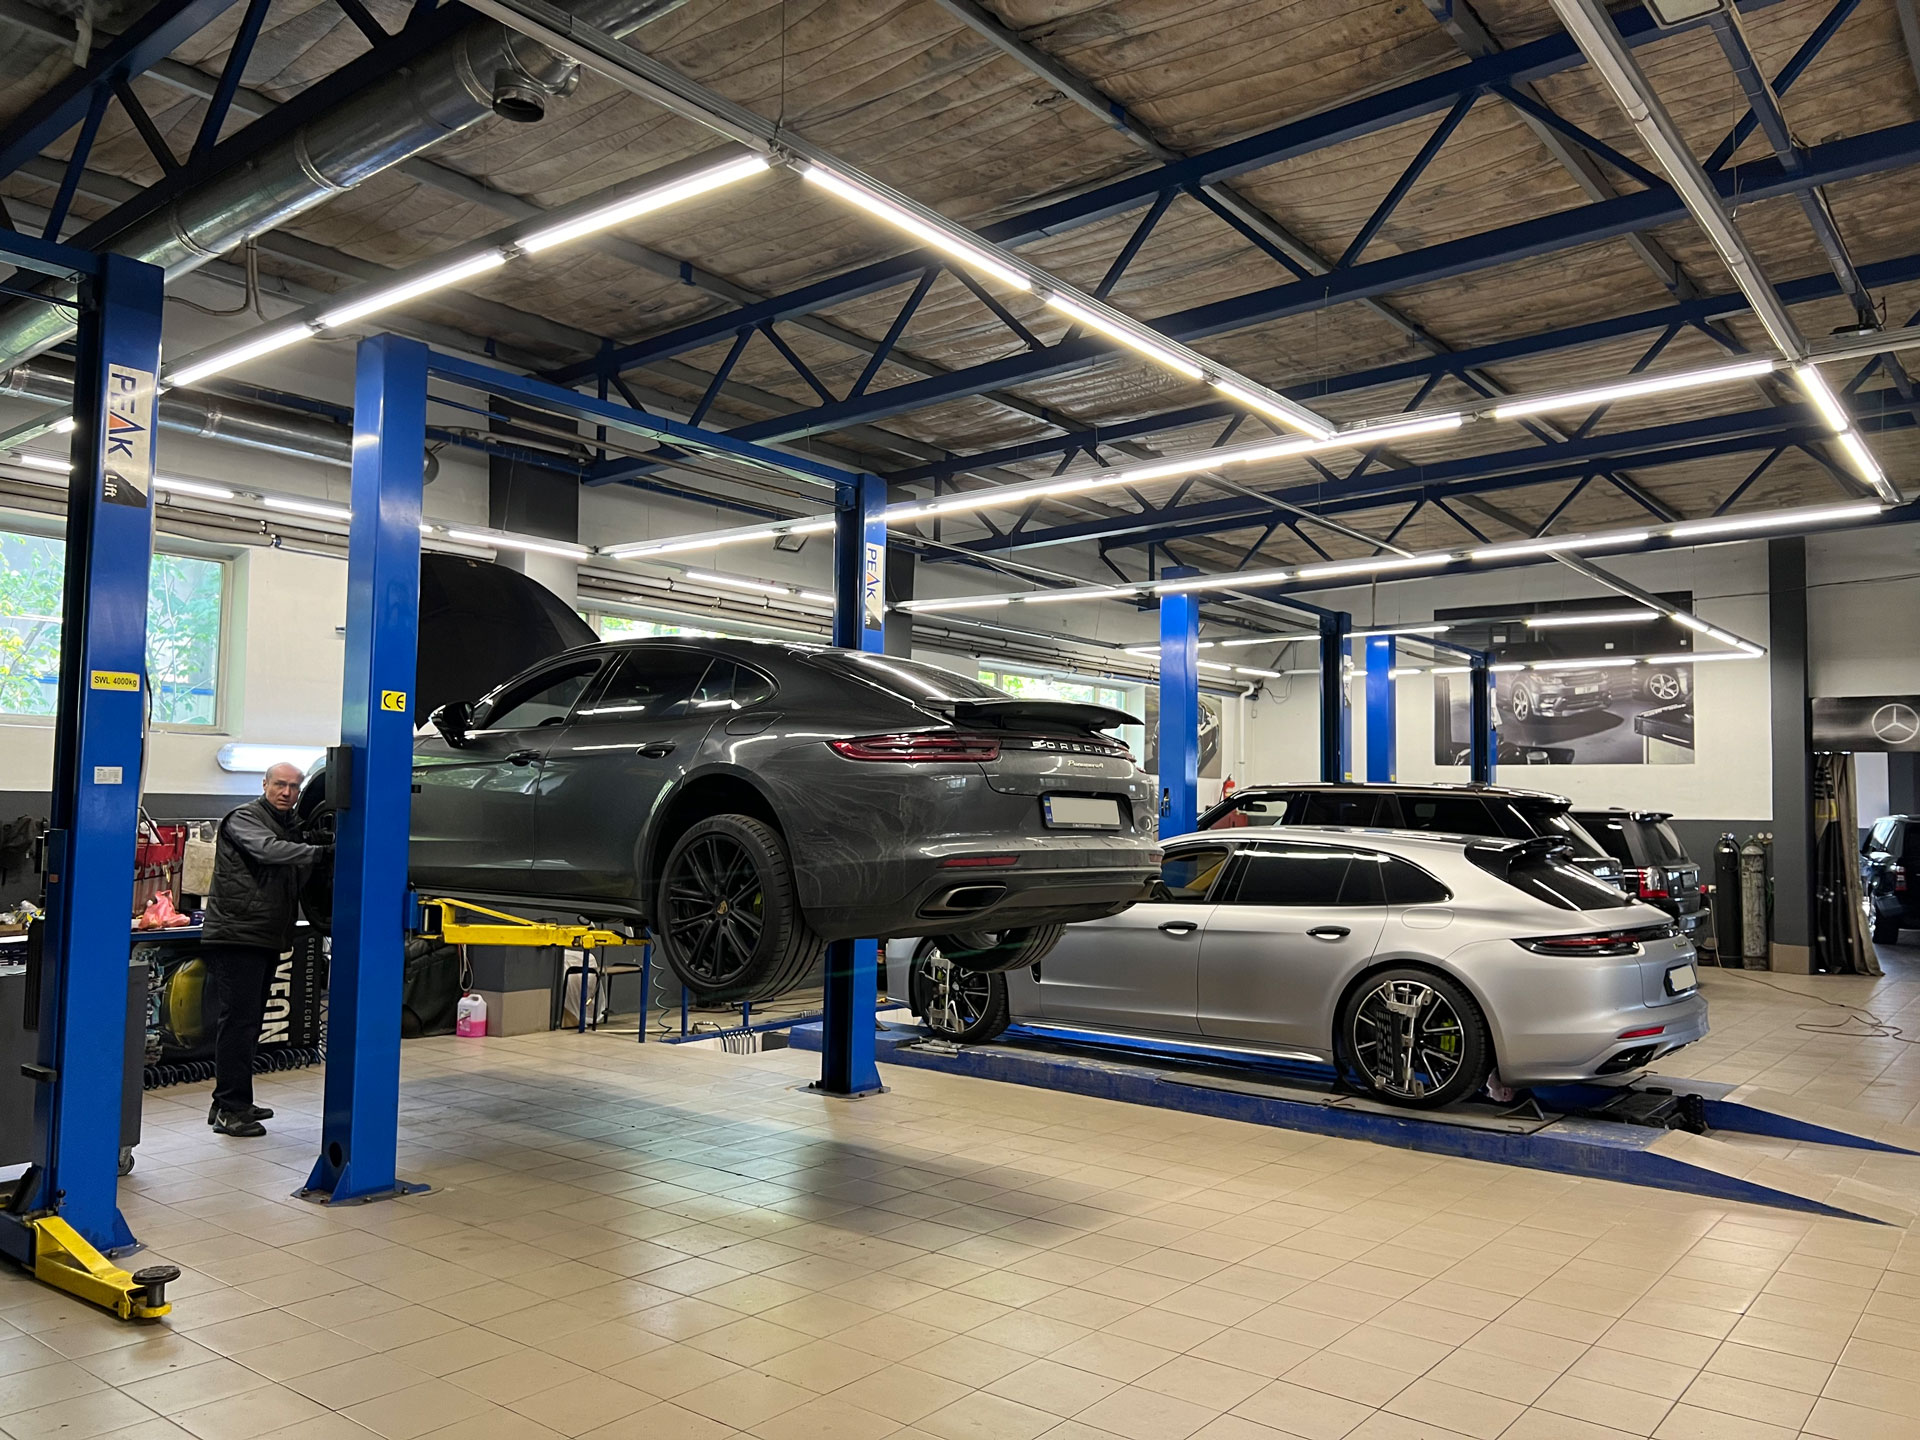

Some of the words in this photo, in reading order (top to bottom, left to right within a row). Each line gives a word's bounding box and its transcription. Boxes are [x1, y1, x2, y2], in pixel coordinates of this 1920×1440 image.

[108, 372, 147, 459] PEAK
[104, 474, 118, 498] Lift
[867, 547, 881, 599] PEAK
[94, 675, 111, 685] SWL
[112, 677, 138, 688] 4000kg
[1031, 740, 1111, 754] PORSCHE
